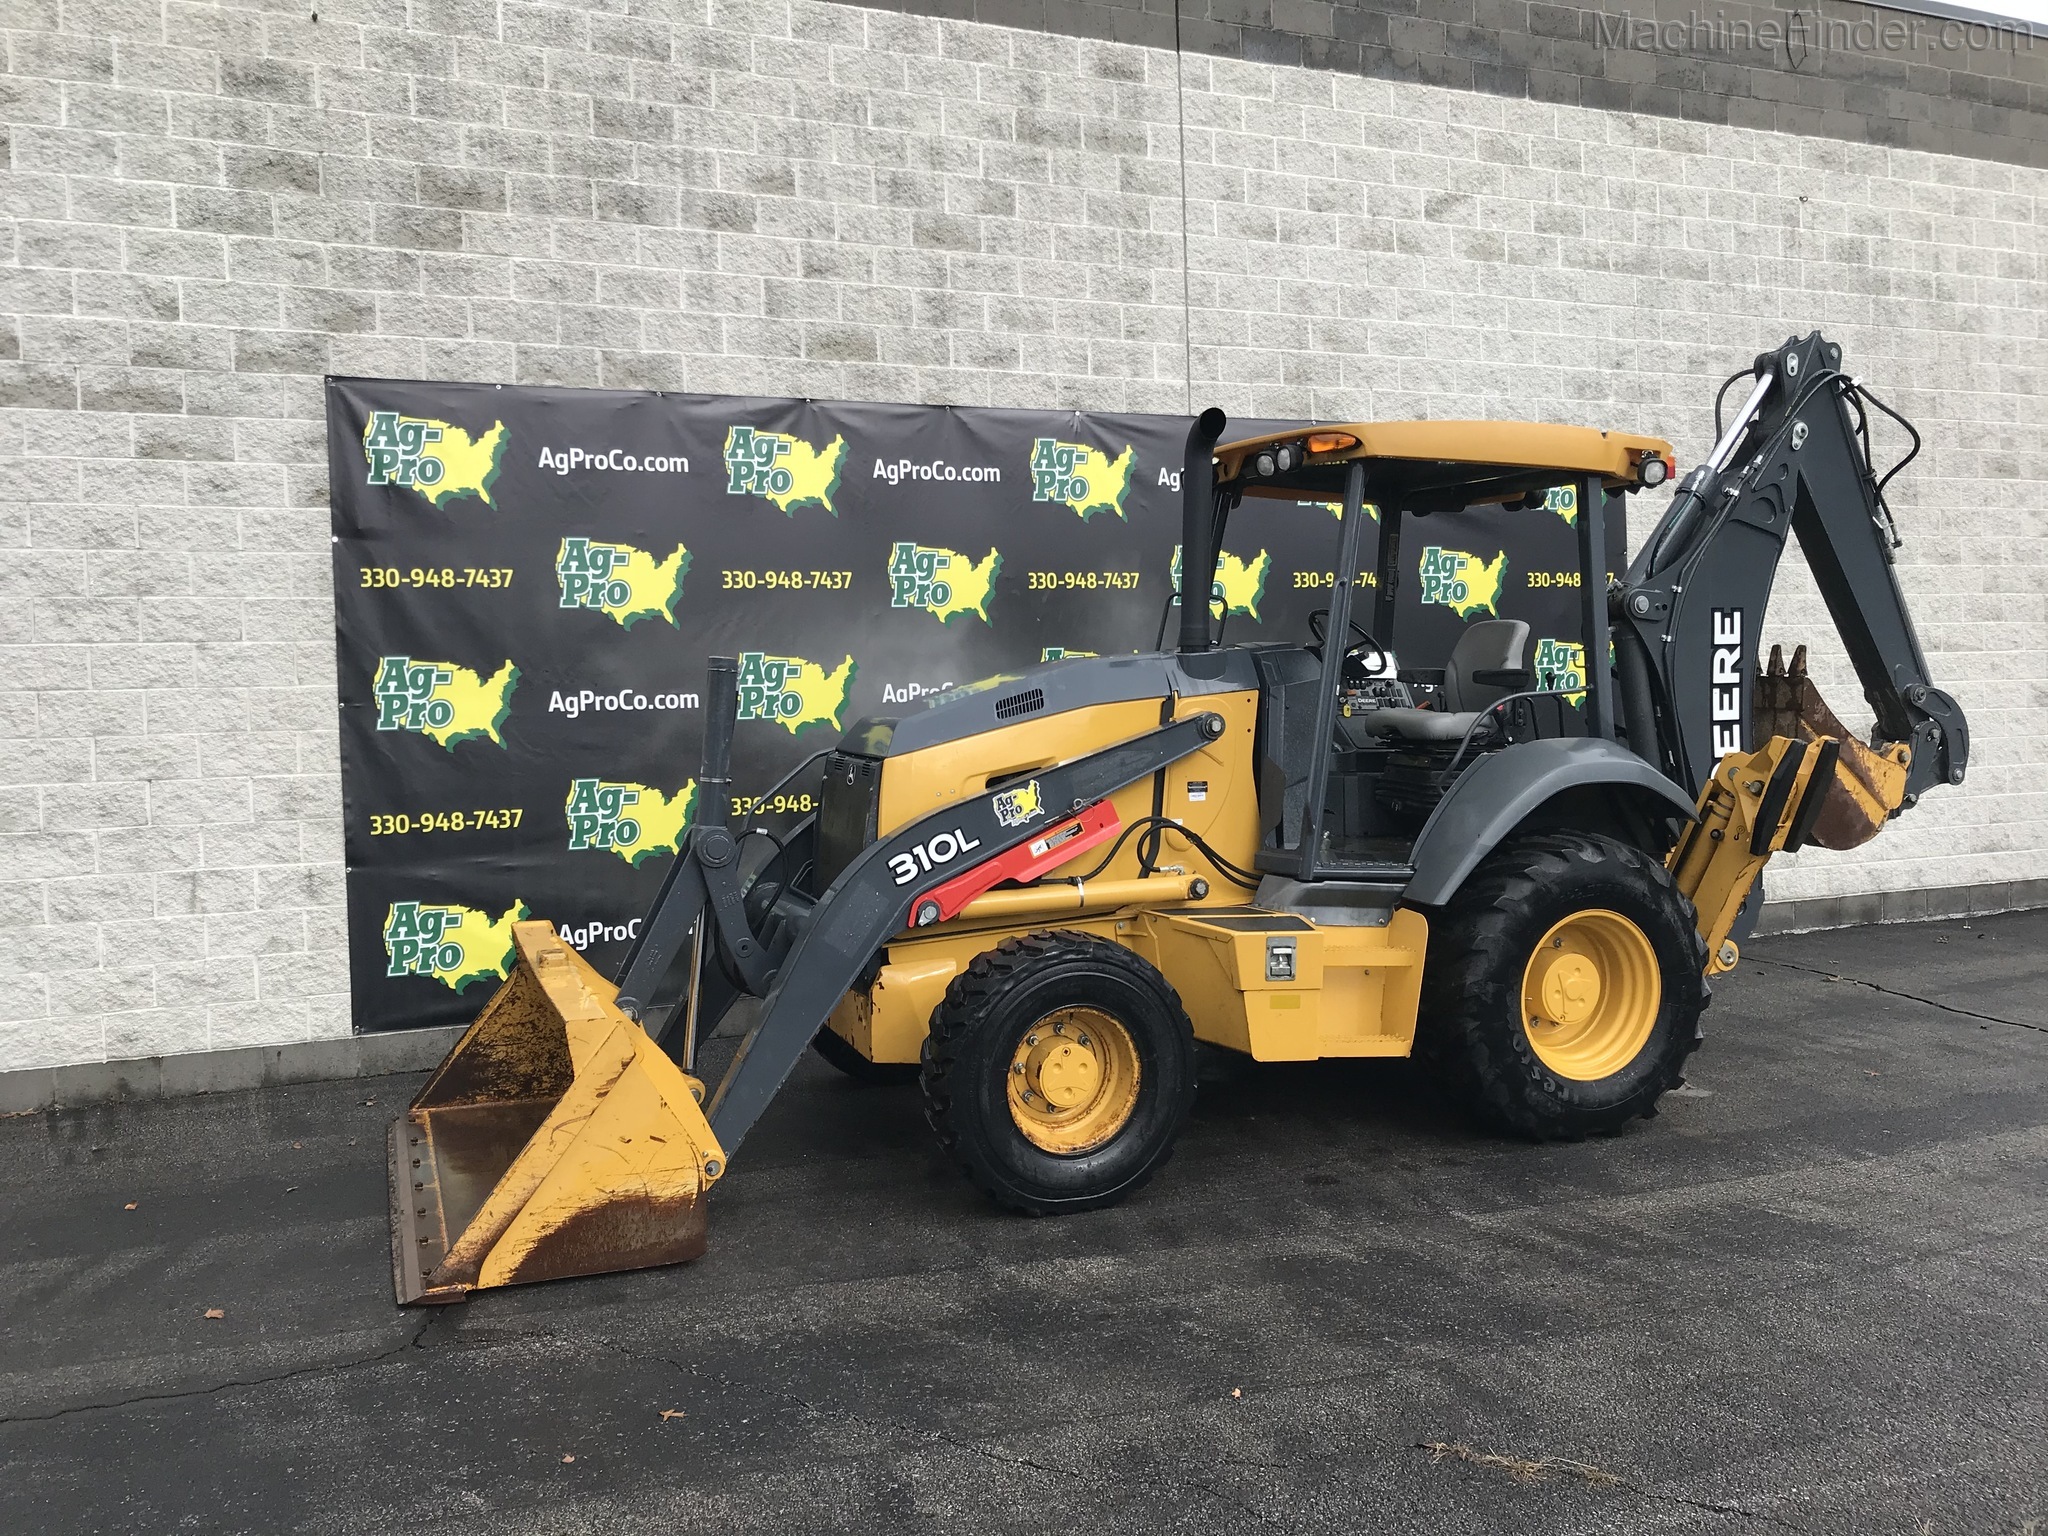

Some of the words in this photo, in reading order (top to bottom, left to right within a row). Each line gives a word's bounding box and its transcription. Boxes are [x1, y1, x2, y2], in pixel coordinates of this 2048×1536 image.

[367, 411, 442, 455] Ag-
[729, 426, 790, 458] Ag-
[367, 448, 444, 485] Pro
[537, 446, 690, 476] AgProCo.com
[1032, 438, 1088, 472] Ag-
[727, 461, 793, 494] Pro
[872, 458, 1001, 486] AgProCo.com
[1032, 470, 1089, 501] Pro
[1547, 486, 1576, 511] ro
[560, 537, 630, 578] Ag-
[892, 543, 950, 577] Ag-
[1421, 547, 1468, 579] Ag-
[360, 567, 514, 588] 330-948-7437
[559, 574, 630, 608] Pro
[722, 570, 853, 590] 330-948-7437
[891, 576, 952, 607] Pro
[1028, 571, 1140, 590] 330-948-7437
[1293, 571, 1377, 588] 330-9-74
[1421, 575, 1469, 604] Pro
[1537, 639, 1579, 668] Ag-
[377, 656, 453, 698] Ag-
[739, 652, 801, 688] Ag-
[548, 688, 700, 719] AgProCo.com
[738, 685, 802, 720] Pro
[1710, 611, 1741, 779] EERE
[376, 693, 453, 731] Pro
[569, 779, 637, 818] Ag-
[731, 794, 819, 816] 330-948-
[996, 794, 1018, 812] Ag-
[1000, 805, 1023, 822] Pro
[369, 808, 523, 836] 330-948-7437
[568, 814, 641, 850] Pro
[888, 828, 981, 885] 310L
[388, 902, 463, 944] Ag-
[559, 918, 642, 951] AgProC
[387, 937, 463, 977] Pro
